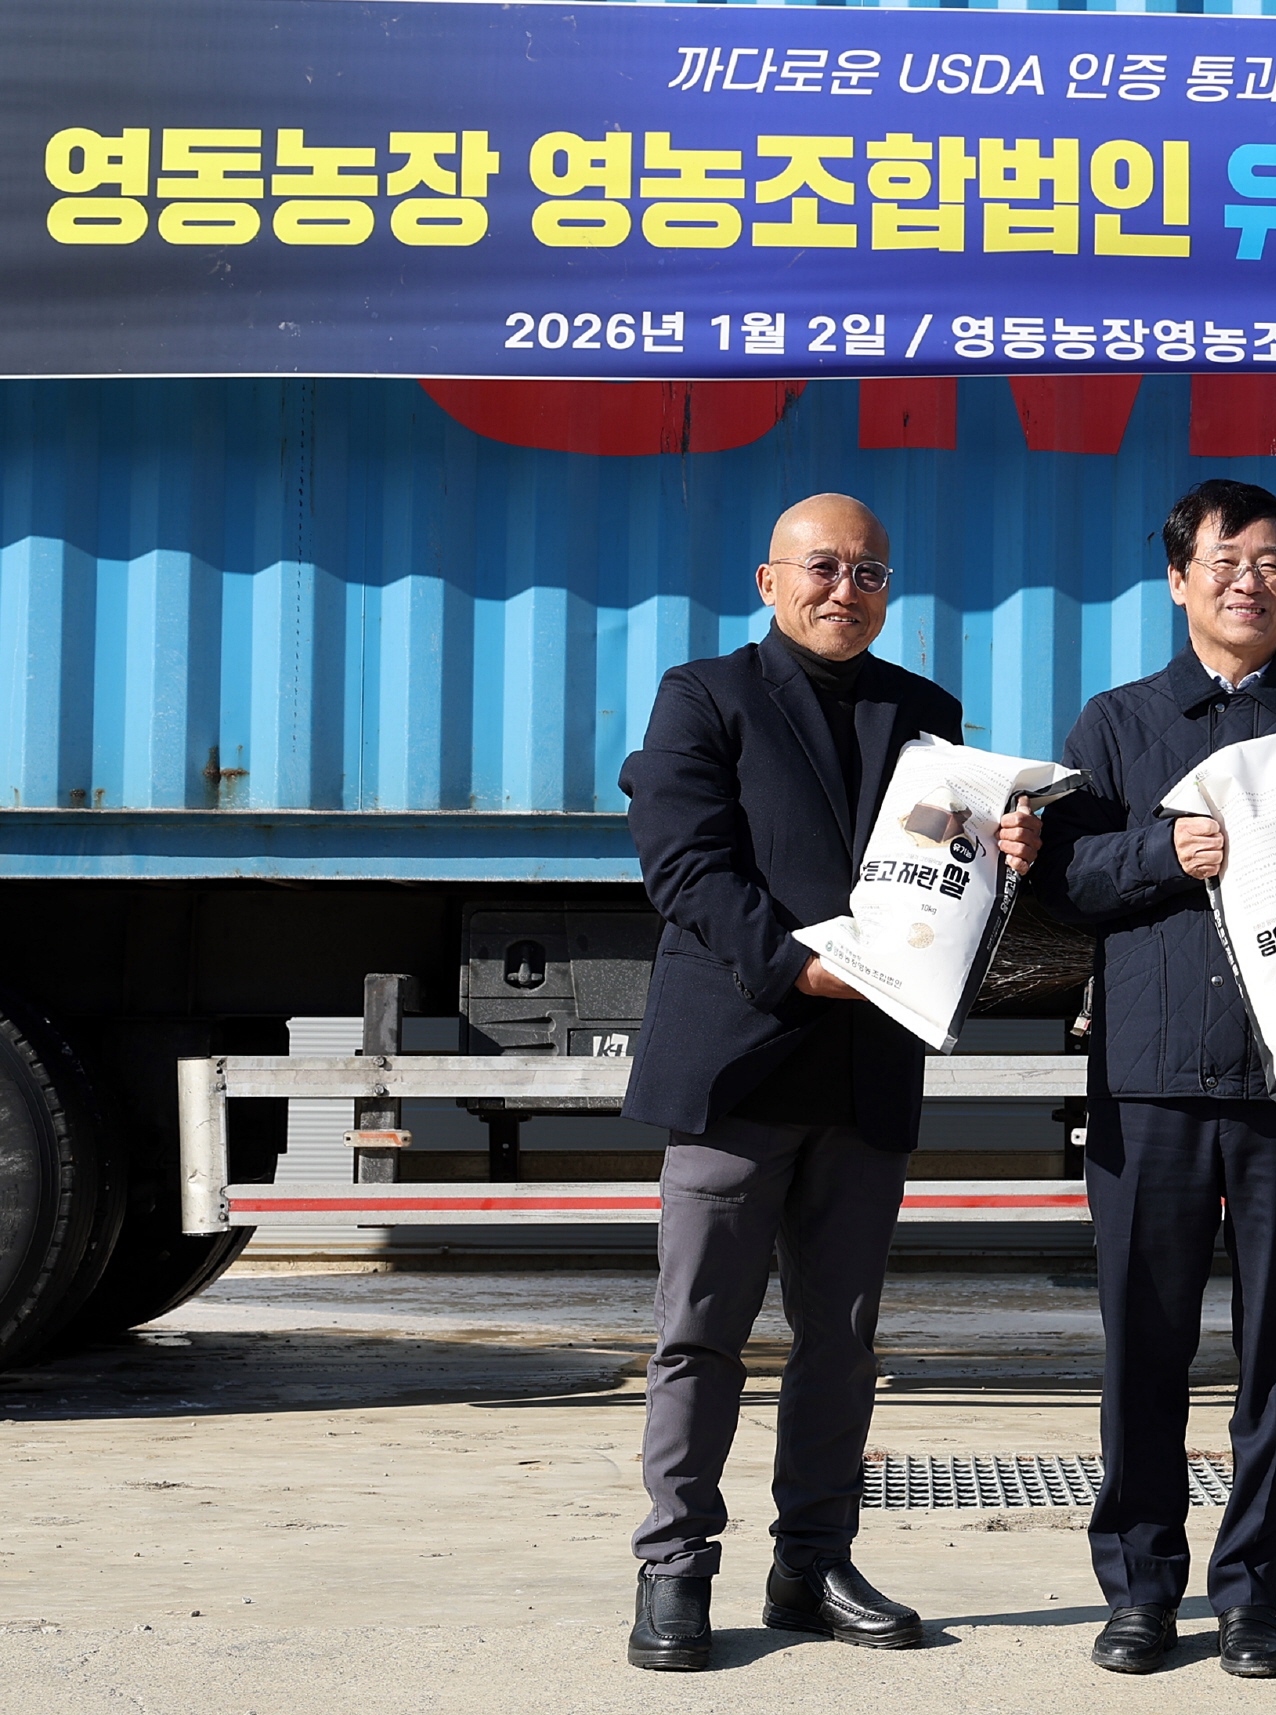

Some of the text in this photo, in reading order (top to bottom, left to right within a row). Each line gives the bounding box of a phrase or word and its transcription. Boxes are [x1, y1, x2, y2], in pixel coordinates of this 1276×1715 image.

[667, 47, 882, 95] 까다로운
[899, 53, 1045, 96] USDA
[1066, 53, 1168, 101] 인증
[45, 127, 500, 246] 영동농장
[529, 131, 1190, 258] 영농조합법인
[504, 311, 684, 353] 2026년
[711, 312, 785, 355] 1월
[808, 313, 885, 356] 2일
[905, 314, 933, 358] /
[896, 861, 939, 890] 자란
[940, 863, 970, 901] 쌀
[921, 903, 937, 916] 10kg
